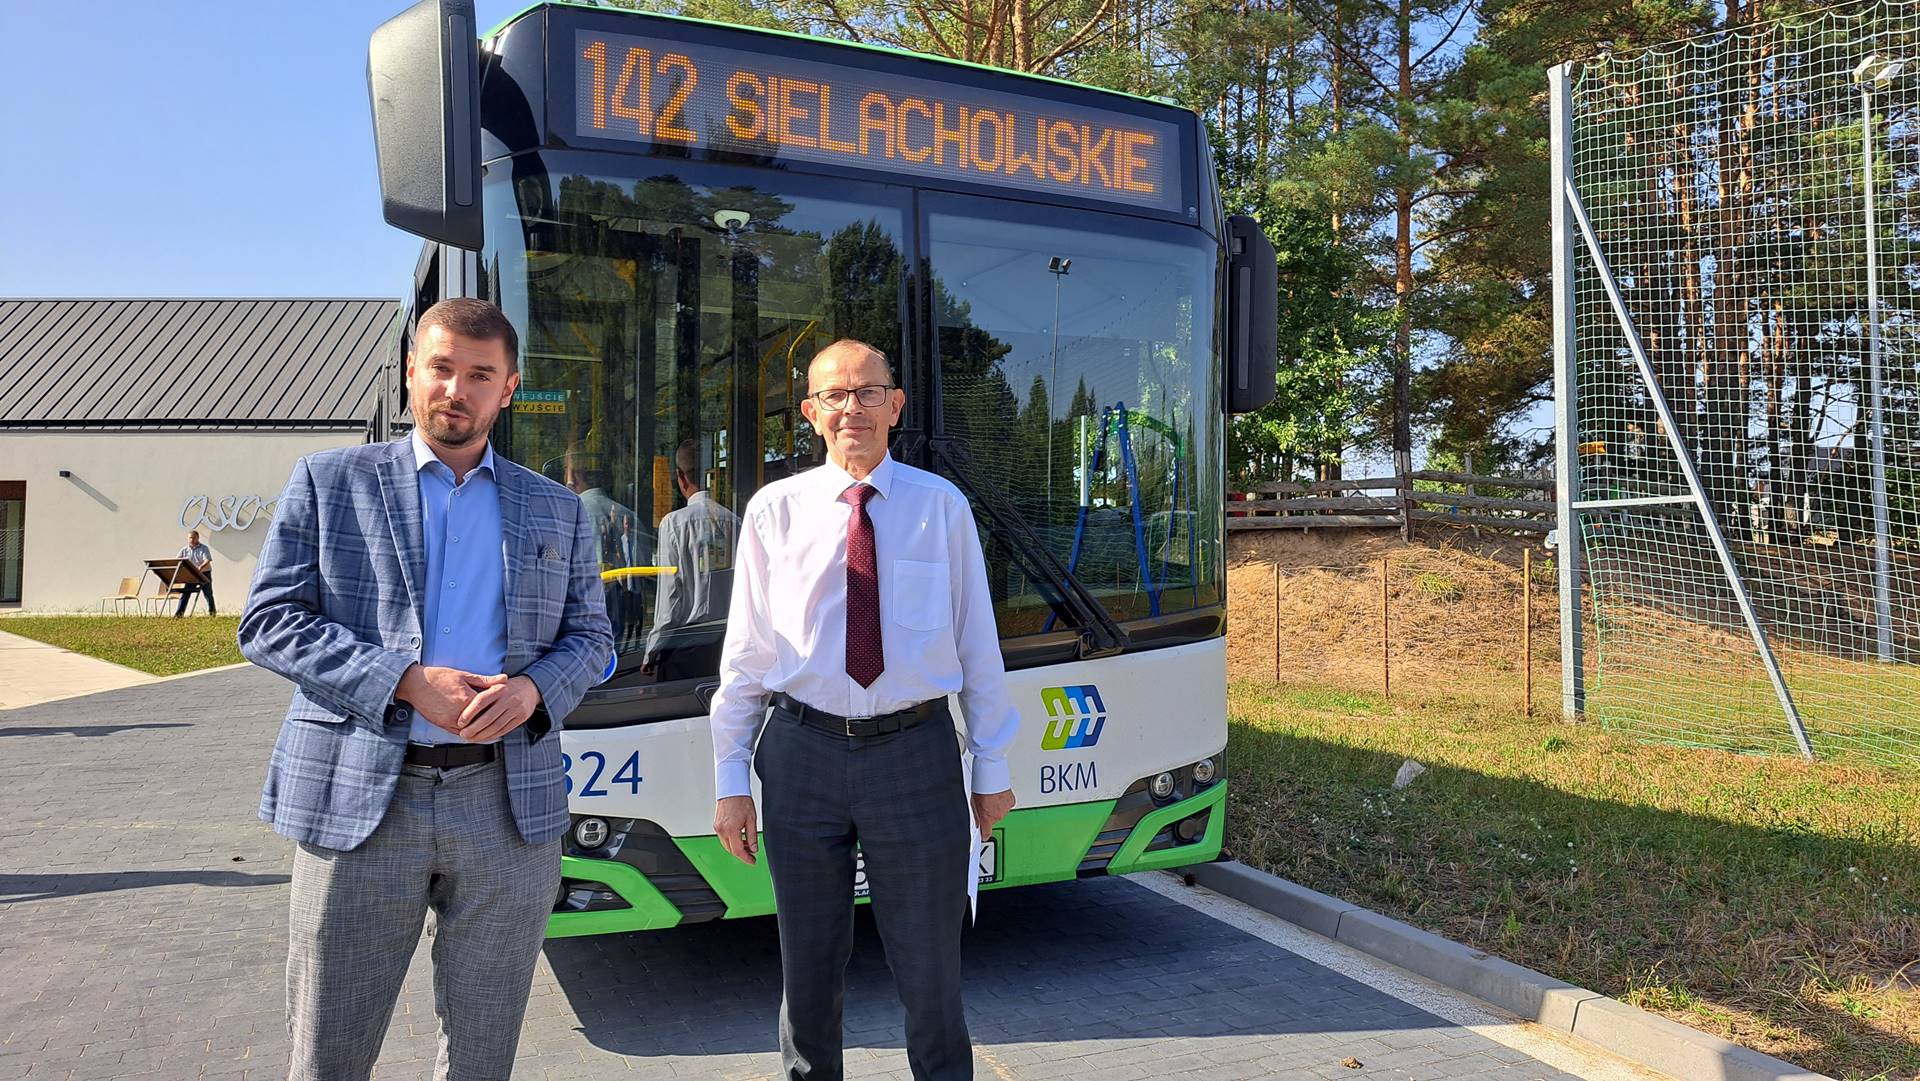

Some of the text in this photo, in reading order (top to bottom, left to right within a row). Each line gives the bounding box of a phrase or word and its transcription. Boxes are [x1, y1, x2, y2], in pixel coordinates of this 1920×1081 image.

[583, 40, 1155, 194] 142 SIELACHOWSKIE
[1041, 761, 1097, 793] BKM
